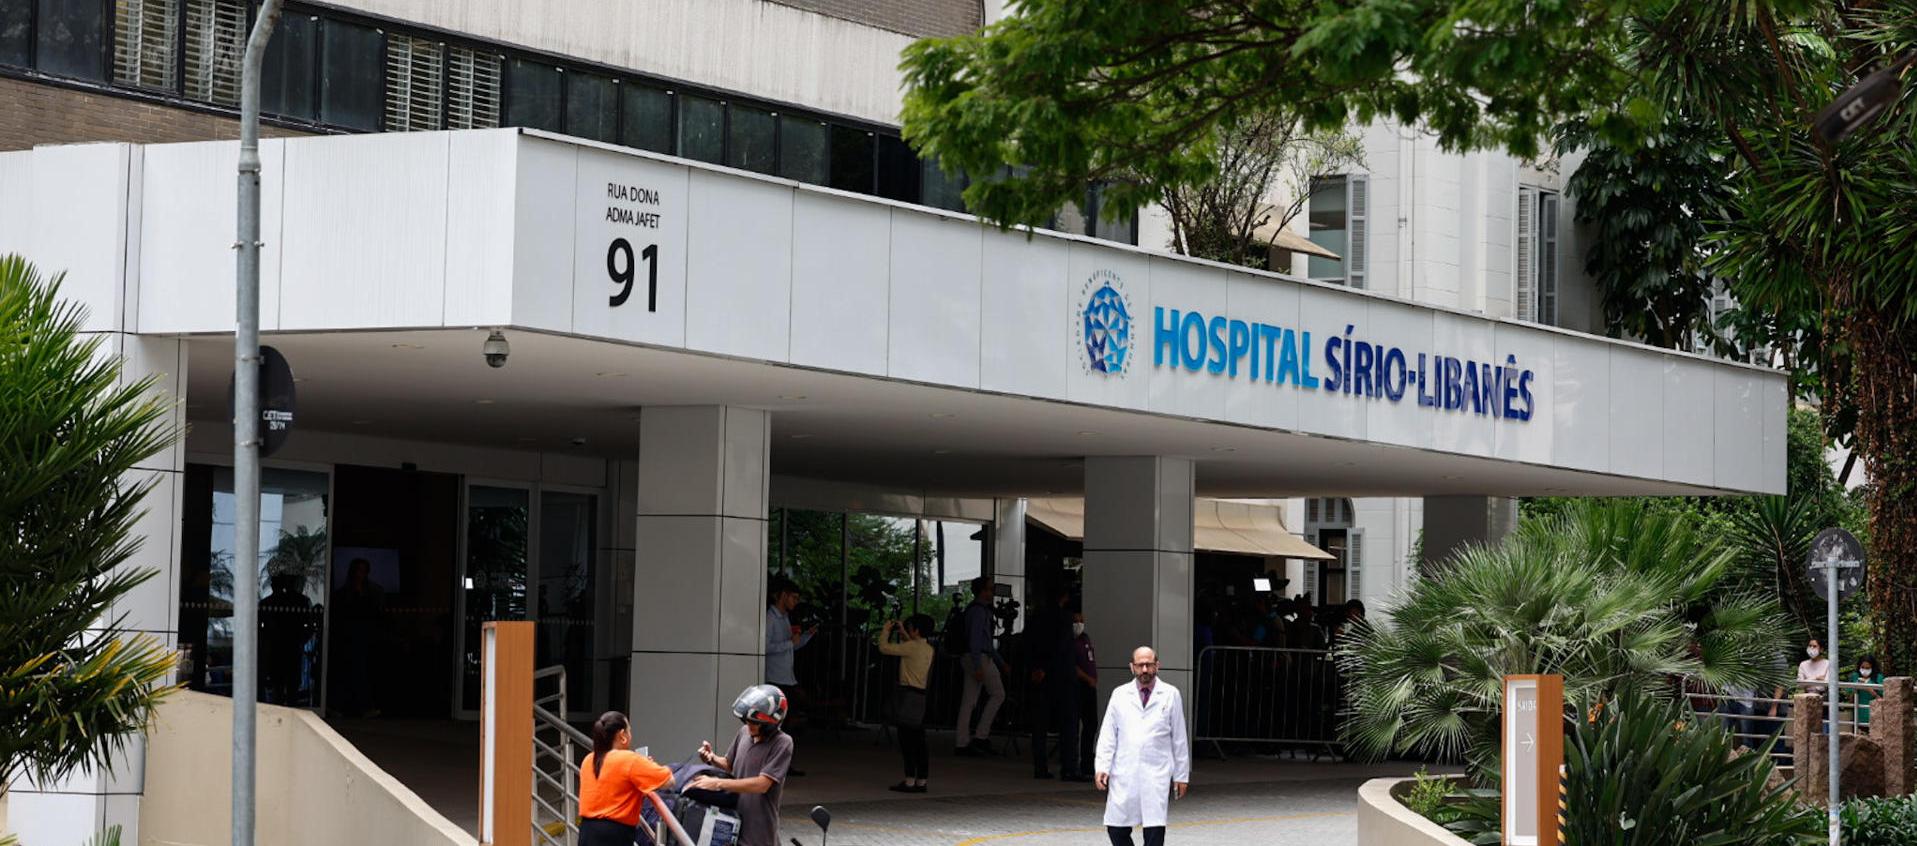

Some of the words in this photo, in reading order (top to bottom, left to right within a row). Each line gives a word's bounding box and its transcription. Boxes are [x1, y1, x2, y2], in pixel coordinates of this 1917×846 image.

[606, 207, 634, 225] ADMA
[635, 211, 661, 229] JAFET
[608, 183, 628, 200] RUA
[630, 186, 660, 206] DONA
[606, 237, 658, 313] 91
[1153, 306, 1320, 389] HOSPITAL
[1324, 324, 1535, 422] SÍRIO-LIBANÊS
